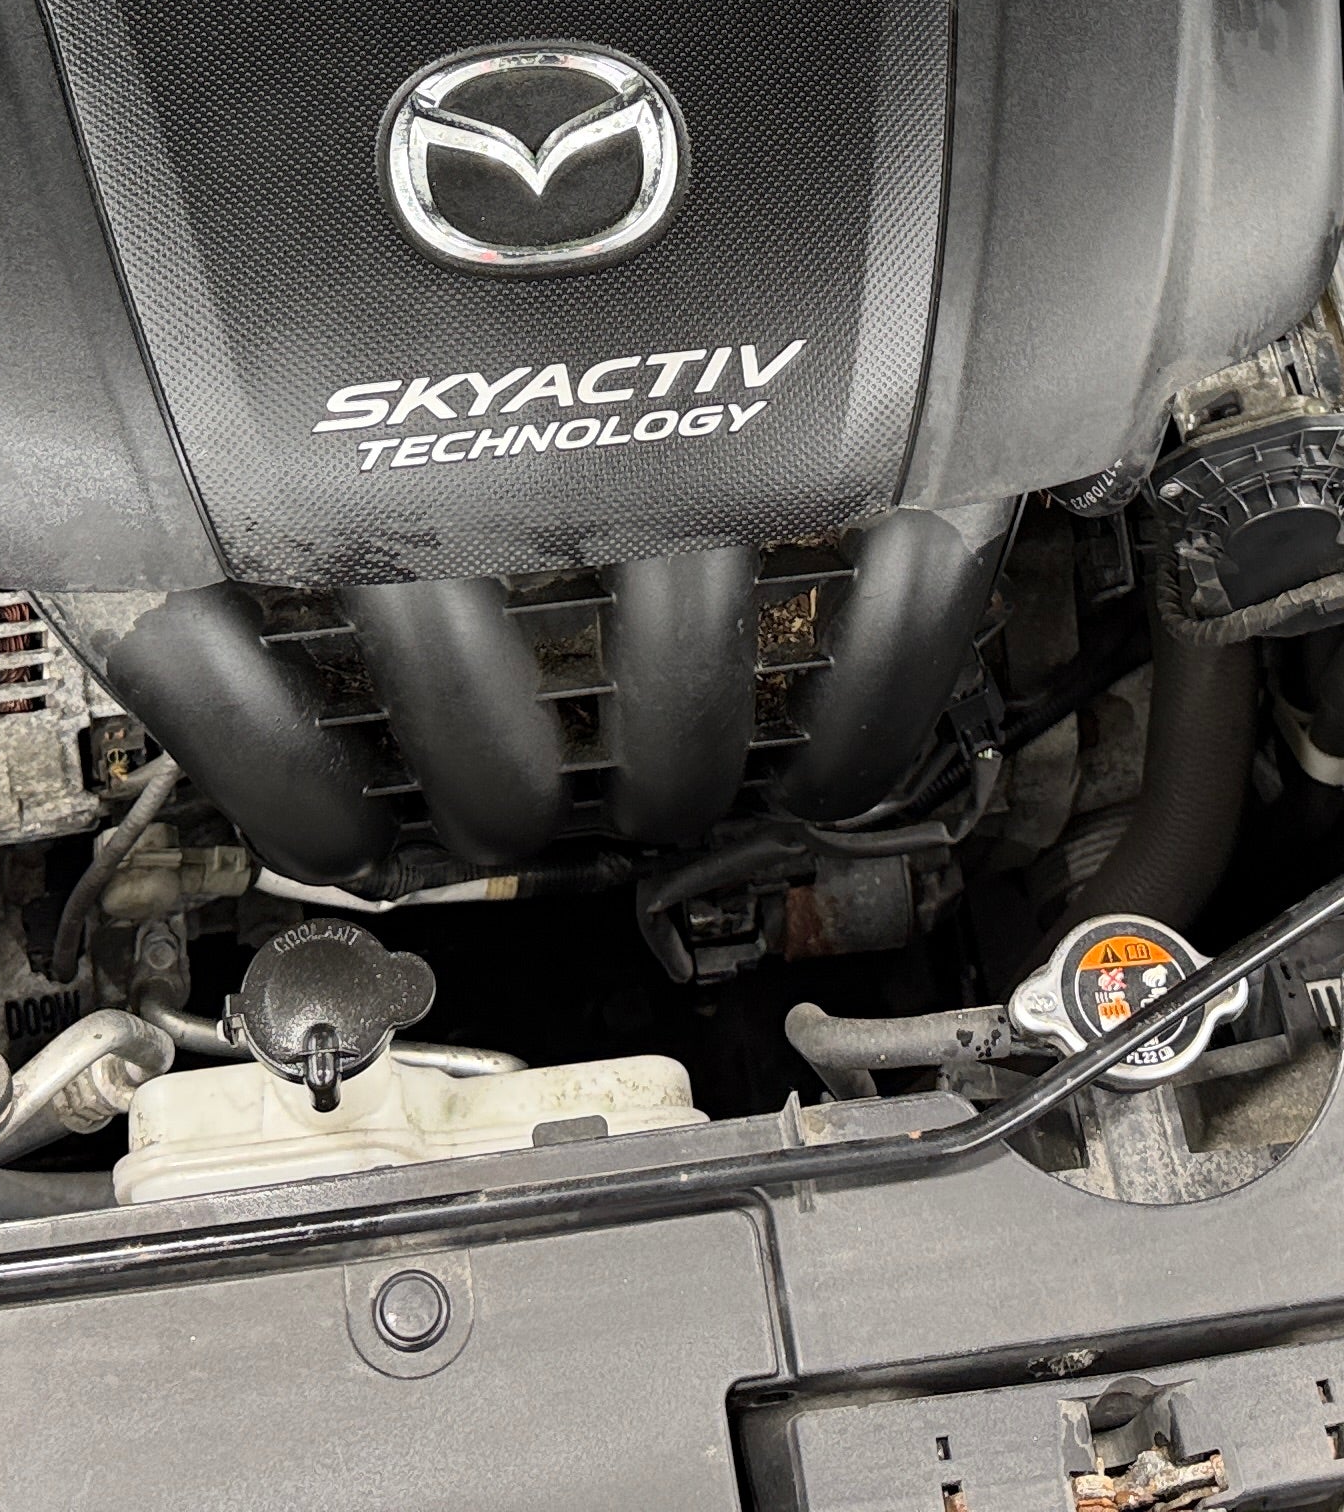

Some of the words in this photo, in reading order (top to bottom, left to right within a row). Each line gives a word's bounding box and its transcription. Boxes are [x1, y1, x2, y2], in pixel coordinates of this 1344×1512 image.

[311, 338, 808, 435] SKYACTIV
[356, 398, 770, 474] TECHNOLOGY
[273, 922, 362, 954] COOLANT
[1126, 1050, 1159, 1065] FL22
